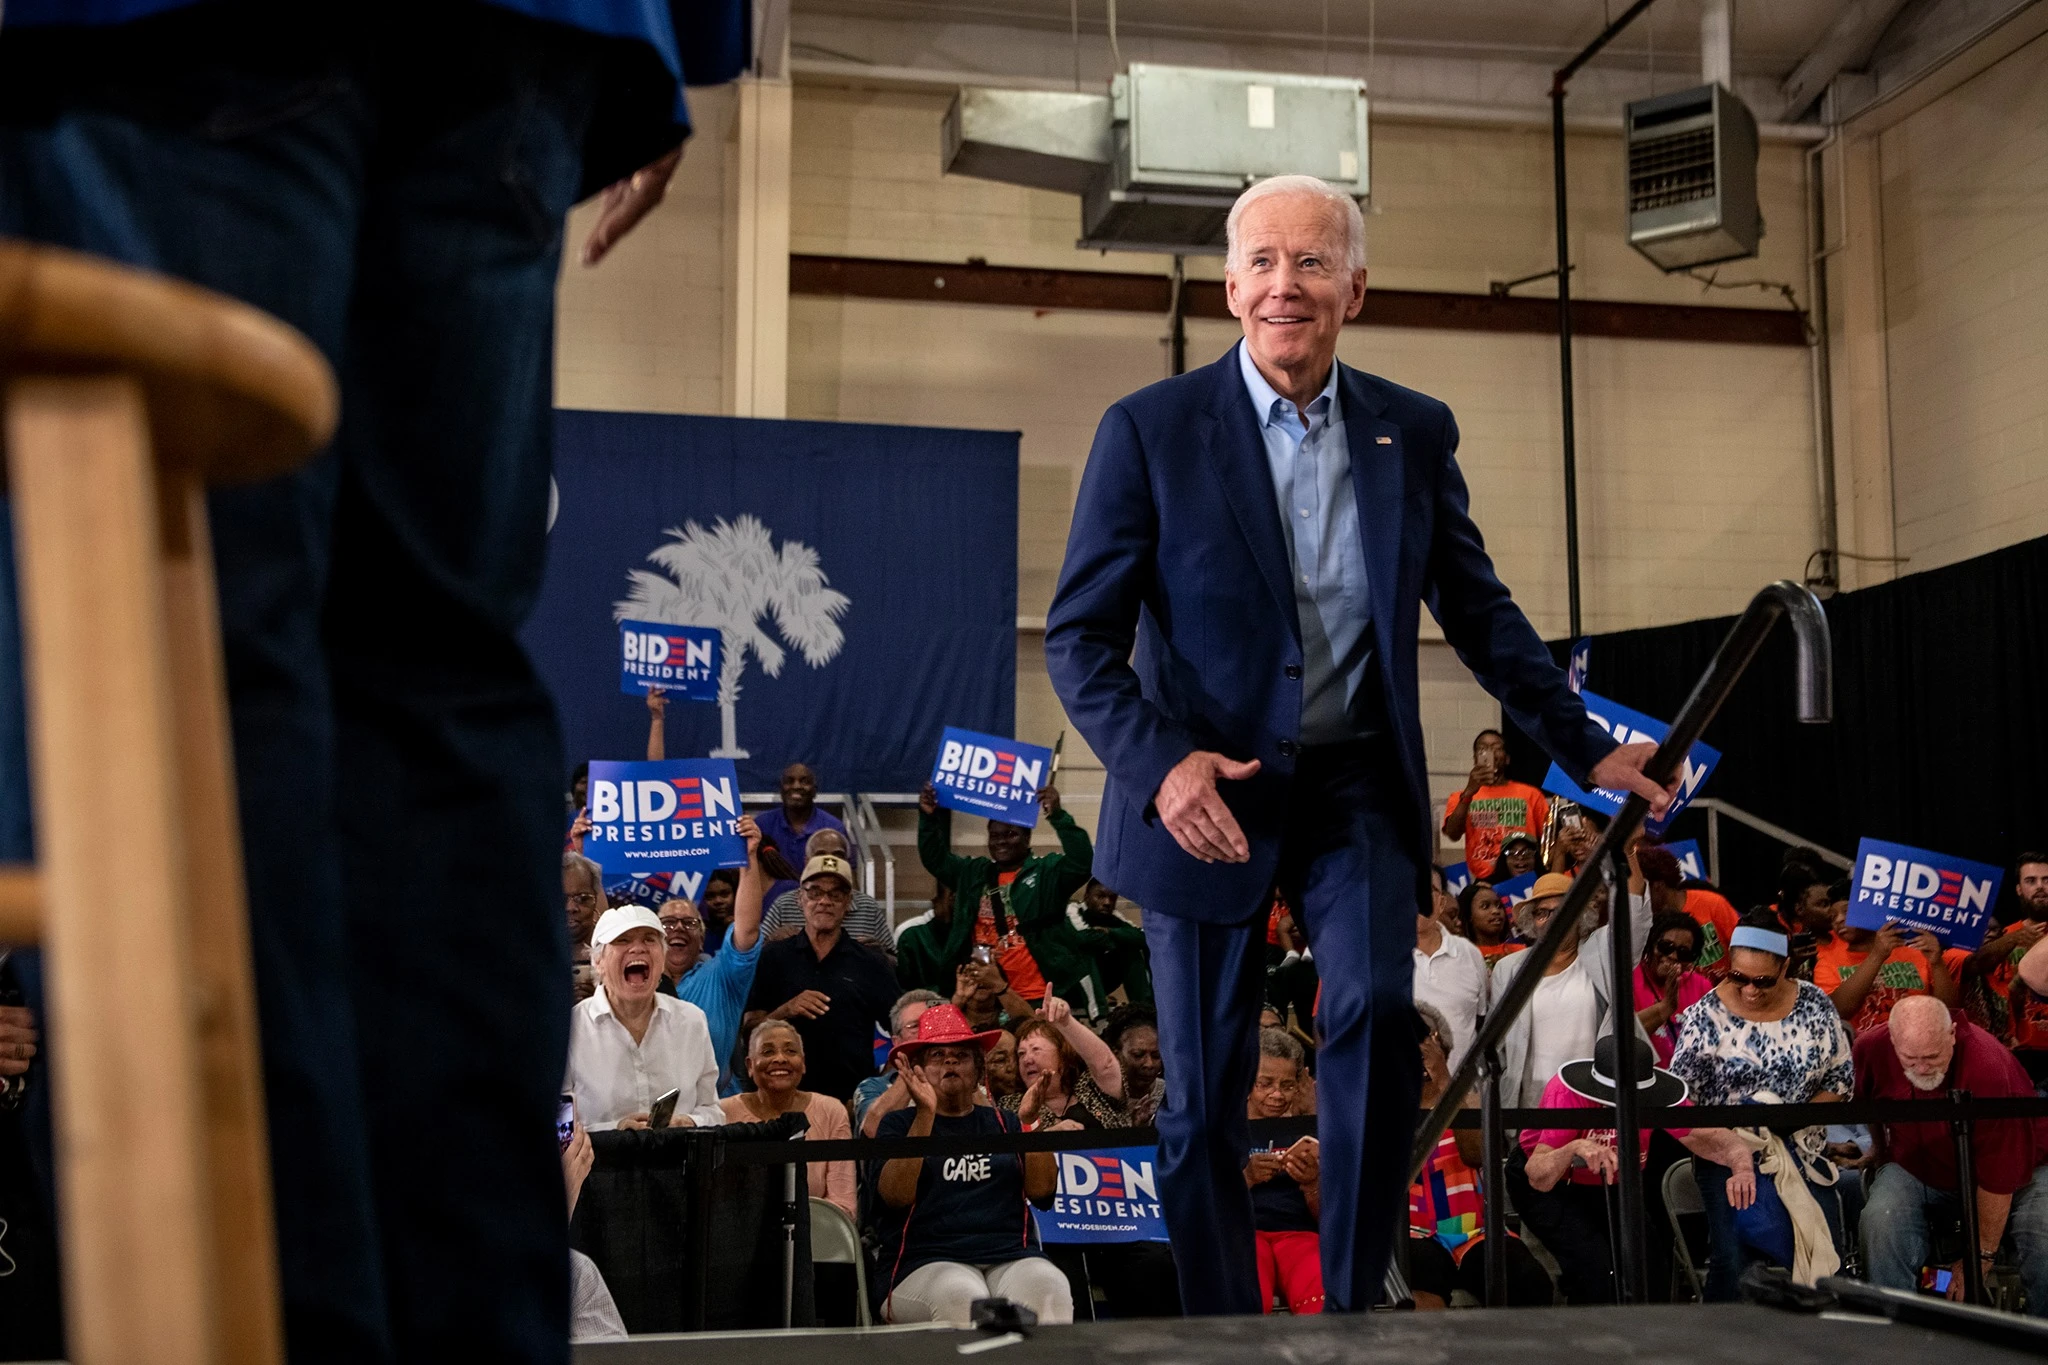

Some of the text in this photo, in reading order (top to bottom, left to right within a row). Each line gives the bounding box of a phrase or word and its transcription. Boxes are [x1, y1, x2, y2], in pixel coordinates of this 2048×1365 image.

[624, 631, 712, 669] BIDEN
[624, 660, 711, 682] PRESIDENT
[938, 740, 1042, 791] BIDEN
[592, 777, 736, 823] BIDEN
[935, 771, 1036, 804] PRESIDENT
[591, 819, 737, 842] PRESIDENT
[624, 847, 710, 859] WWW.JOEBIDEN.COM
[1861, 853, 1993, 913] BIDEN
[1857, 889, 1983, 928] PRESIDENT
[943, 1157, 991, 1182] CARE
[1053, 1197, 1160, 1219] ESIDENT
